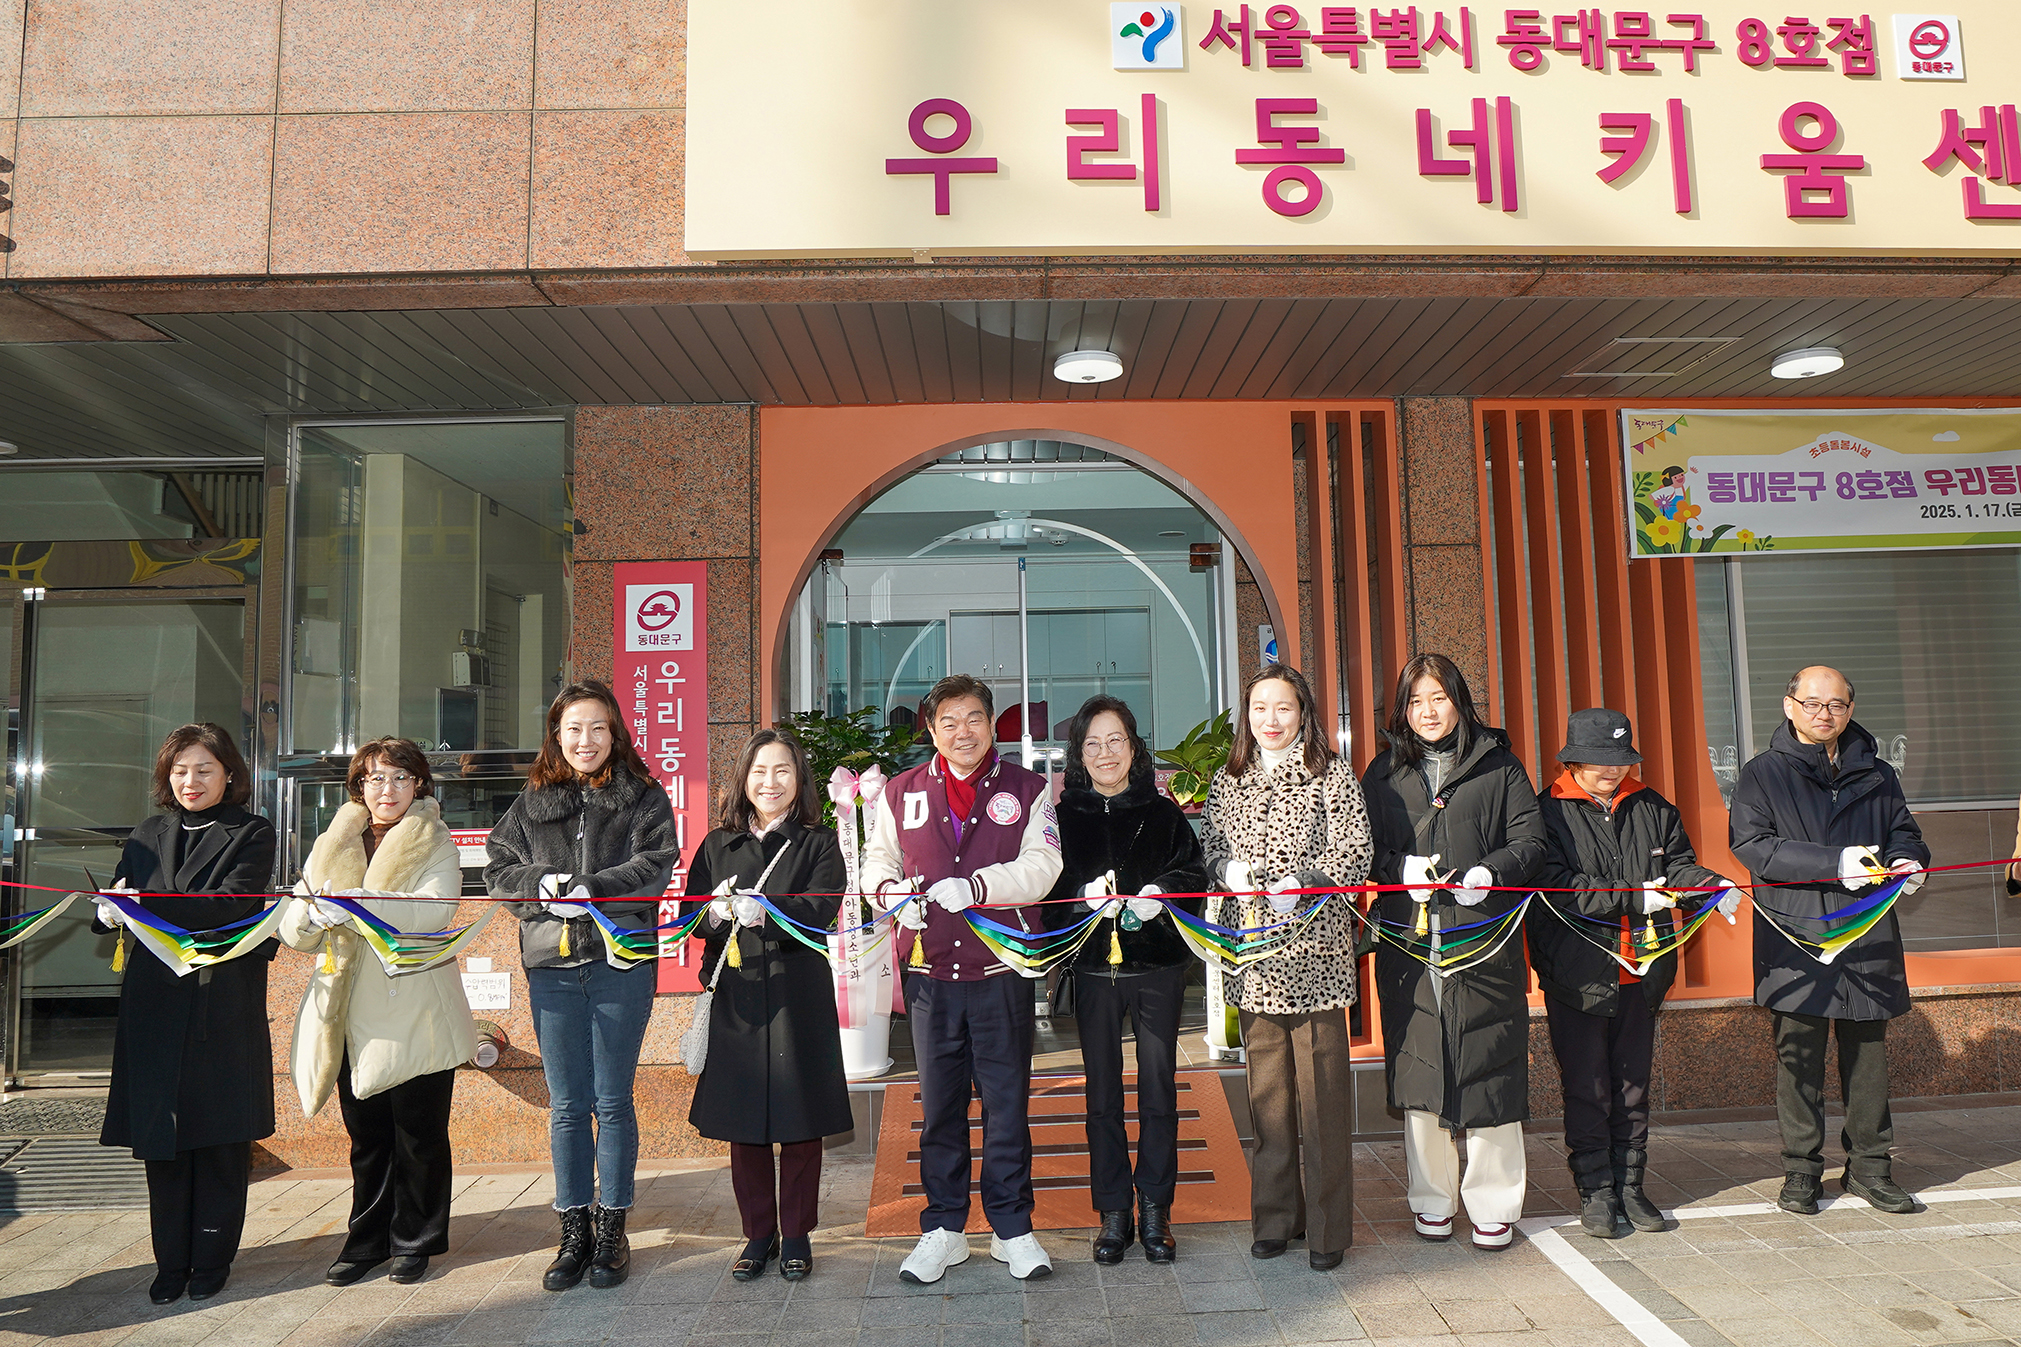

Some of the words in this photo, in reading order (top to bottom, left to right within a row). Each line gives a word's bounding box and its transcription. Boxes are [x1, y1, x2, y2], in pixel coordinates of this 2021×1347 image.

[1199, 3, 1473, 69] 서울특별시
[1496, 8, 1716, 73] 동대문구
[1735, 14, 1877, 76] 8호점
[1911, 61, 1954, 74] 동대문구
[1808, 439, 1872, 459] 초등돌봄시설
[1707, 471, 1827, 503] 동대문구
[1835, 469, 1918, 500] 8호점
[1920, 503, 1961, 518] 2025.
[637, 633, 682, 646] 동대문구
[633, 665, 649, 752] 서울특별시
[902, 791, 931, 830] D
